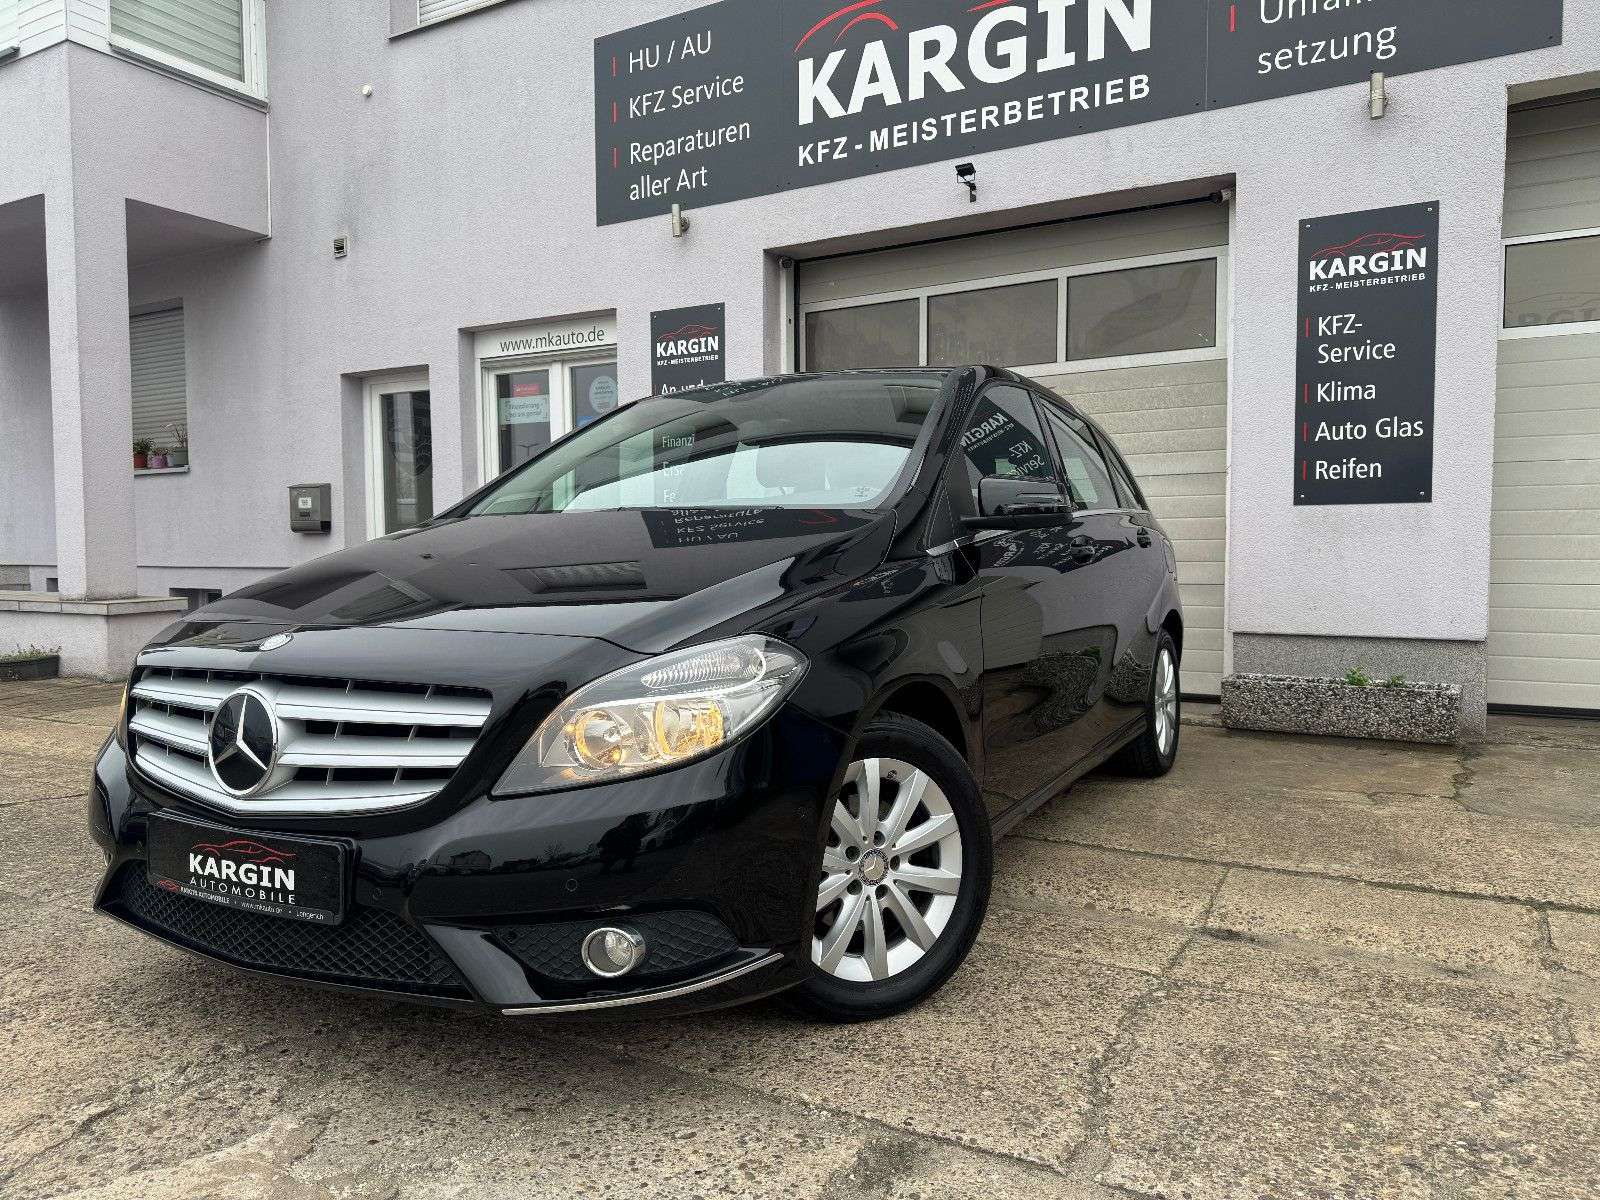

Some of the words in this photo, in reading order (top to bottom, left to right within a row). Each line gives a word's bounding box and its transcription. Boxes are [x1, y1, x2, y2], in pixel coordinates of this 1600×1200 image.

[628, 44, 660, 73] HU
[680, 30, 712, 60] AU
[798, 0, 1151, 126] KARGIN
[1257, 25, 1397, 74] setzung
[629, 89, 665, 118] KFZ
[672, 75, 744, 109] Service
[630, 122, 750, 165] Reparaturen
[629, 174, 671, 201] aller
[676, 166, 708, 192] Art
[1309, 246, 1427, 281] KARGIN
[500, 325, 605, 352] www.mkauto.de
[1318, 313, 1363, 337] KFZ-
[656, 335, 719, 358] KARGIN
[1318, 340, 1396, 364] Service
[1316, 380, 1376, 402] Klima
[1314, 421, 1367, 441] Auto
[1375, 415, 1424, 439] Glas
[1315, 457, 1382, 479] Reifen
[188, 852, 295, 891] KARGIN
[189, 877, 296, 905] AUTOMOBILE
